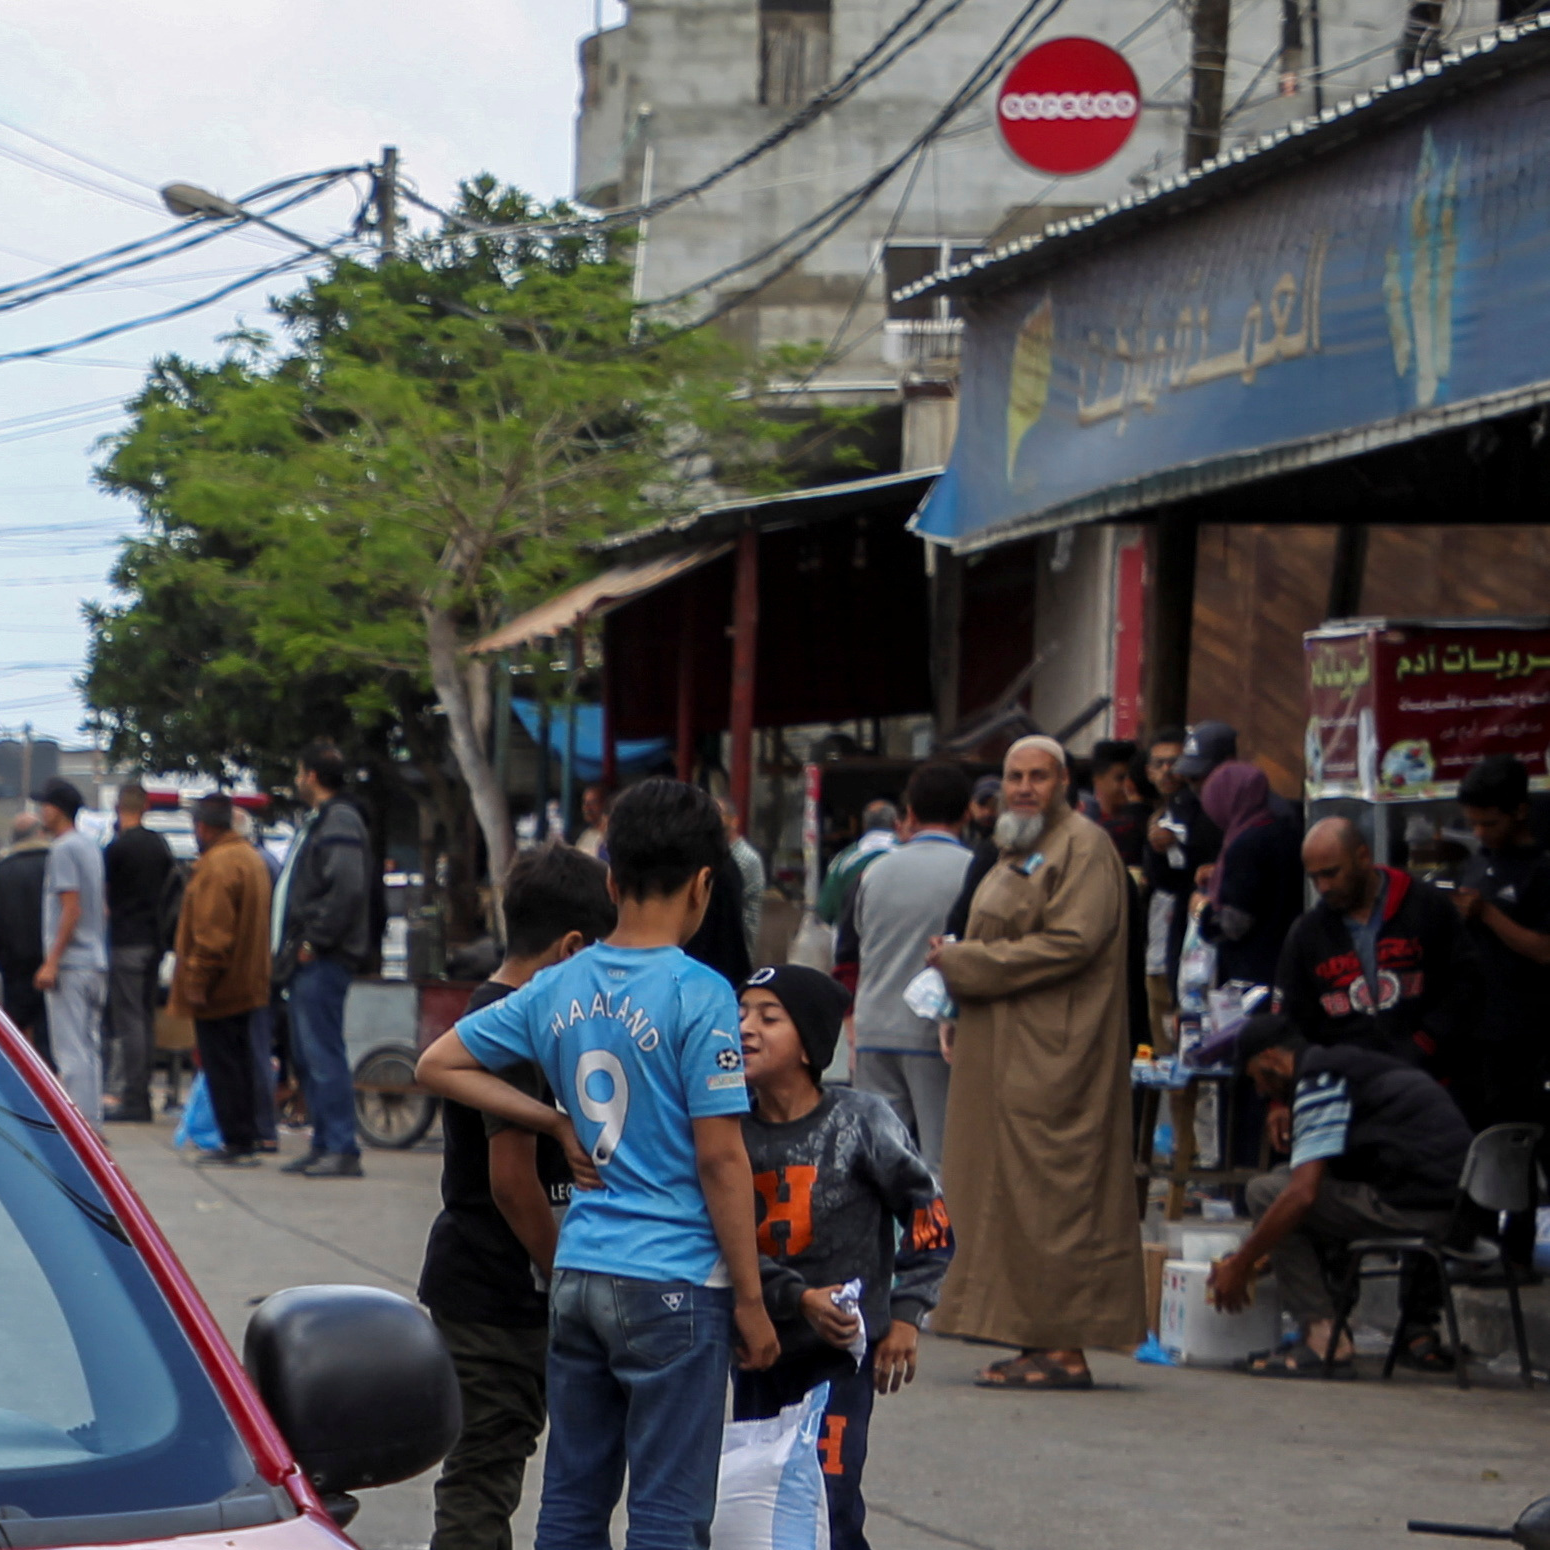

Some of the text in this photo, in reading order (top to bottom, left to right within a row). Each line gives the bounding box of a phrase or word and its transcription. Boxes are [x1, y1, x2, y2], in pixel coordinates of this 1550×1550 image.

[1000, 92, 1137, 120] ooredoo
[551, 991, 660, 1052] HAALAND
[575, 1049, 629, 1166] 9
